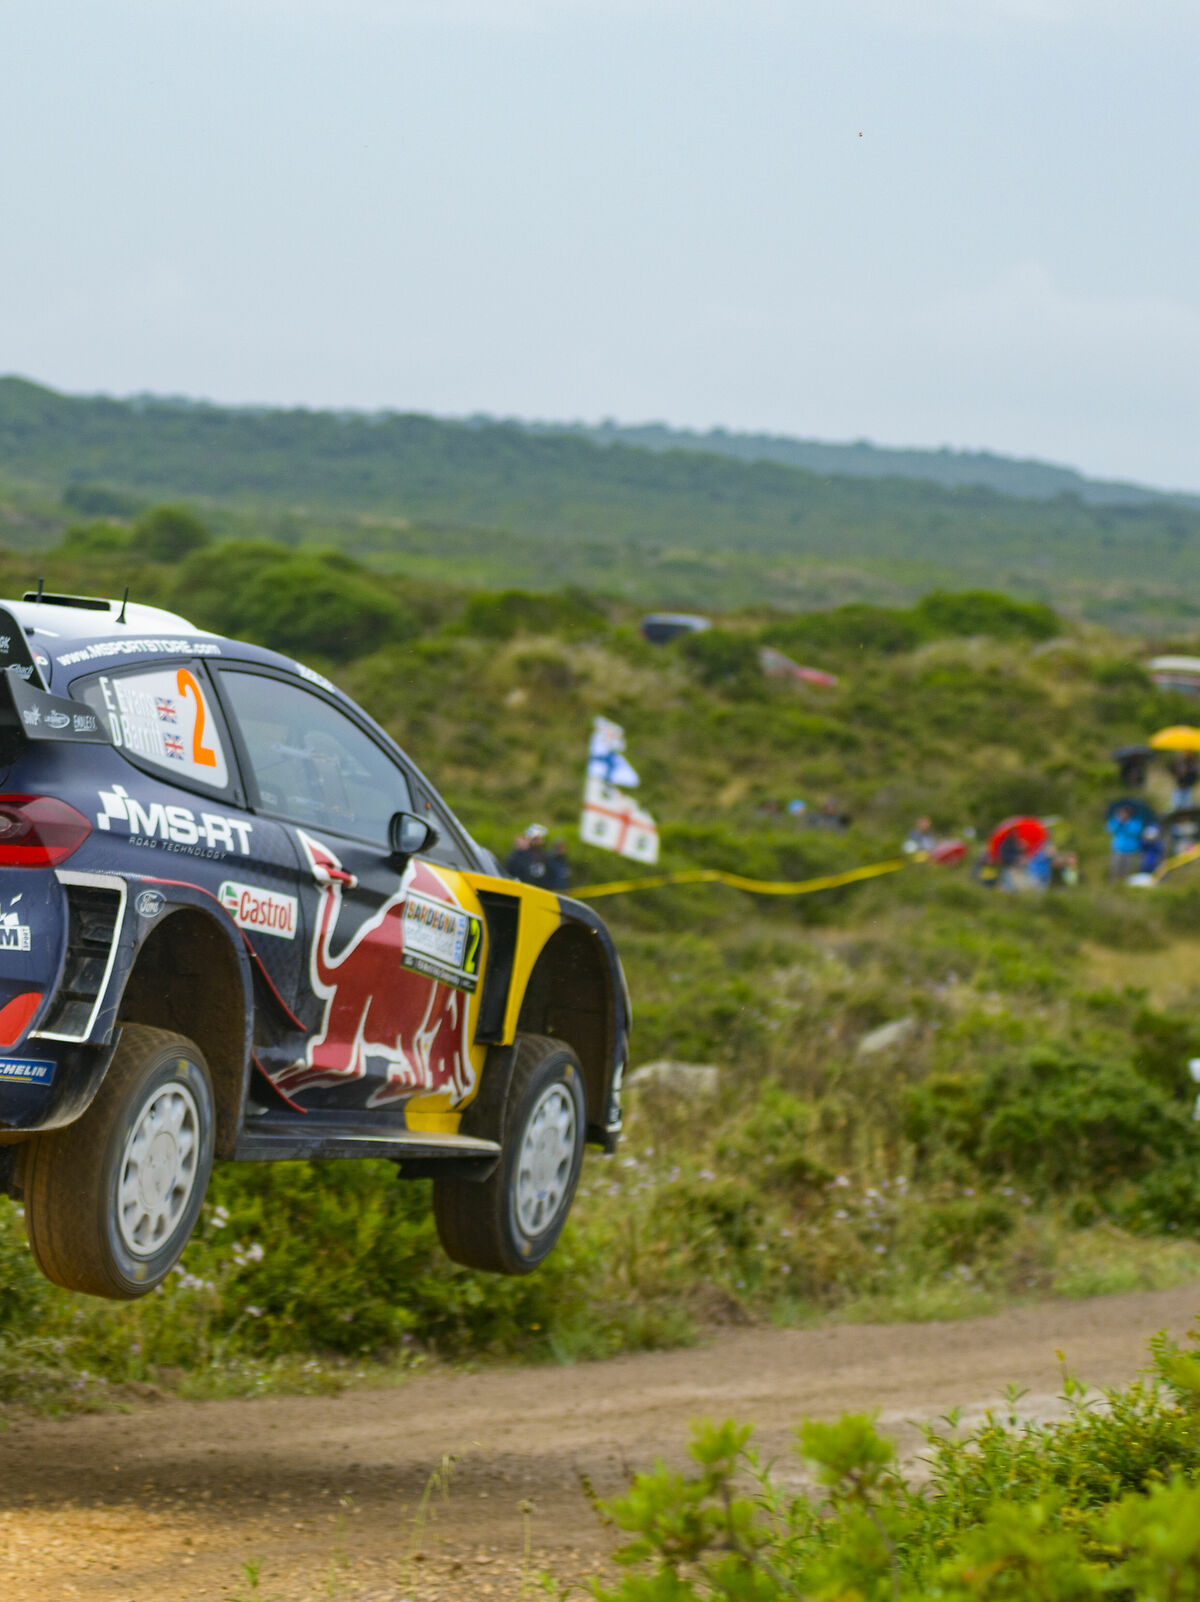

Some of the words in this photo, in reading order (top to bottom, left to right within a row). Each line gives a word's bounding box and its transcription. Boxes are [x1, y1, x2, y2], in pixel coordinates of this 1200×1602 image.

[56, 639, 222, 667] www.MSPORTSTORE.com
[99, 677, 116, 710] E
[108, 712, 122, 747] D
[176, 668, 217, 768] 2
[124, 797, 253, 856] MS-RT
[129, 836, 158, 850] ROAD
[162, 841, 227, 860] TECHNOLOGY
[239, 891, 294, 932] Castrol
[464, 917, 481, 974] 2
